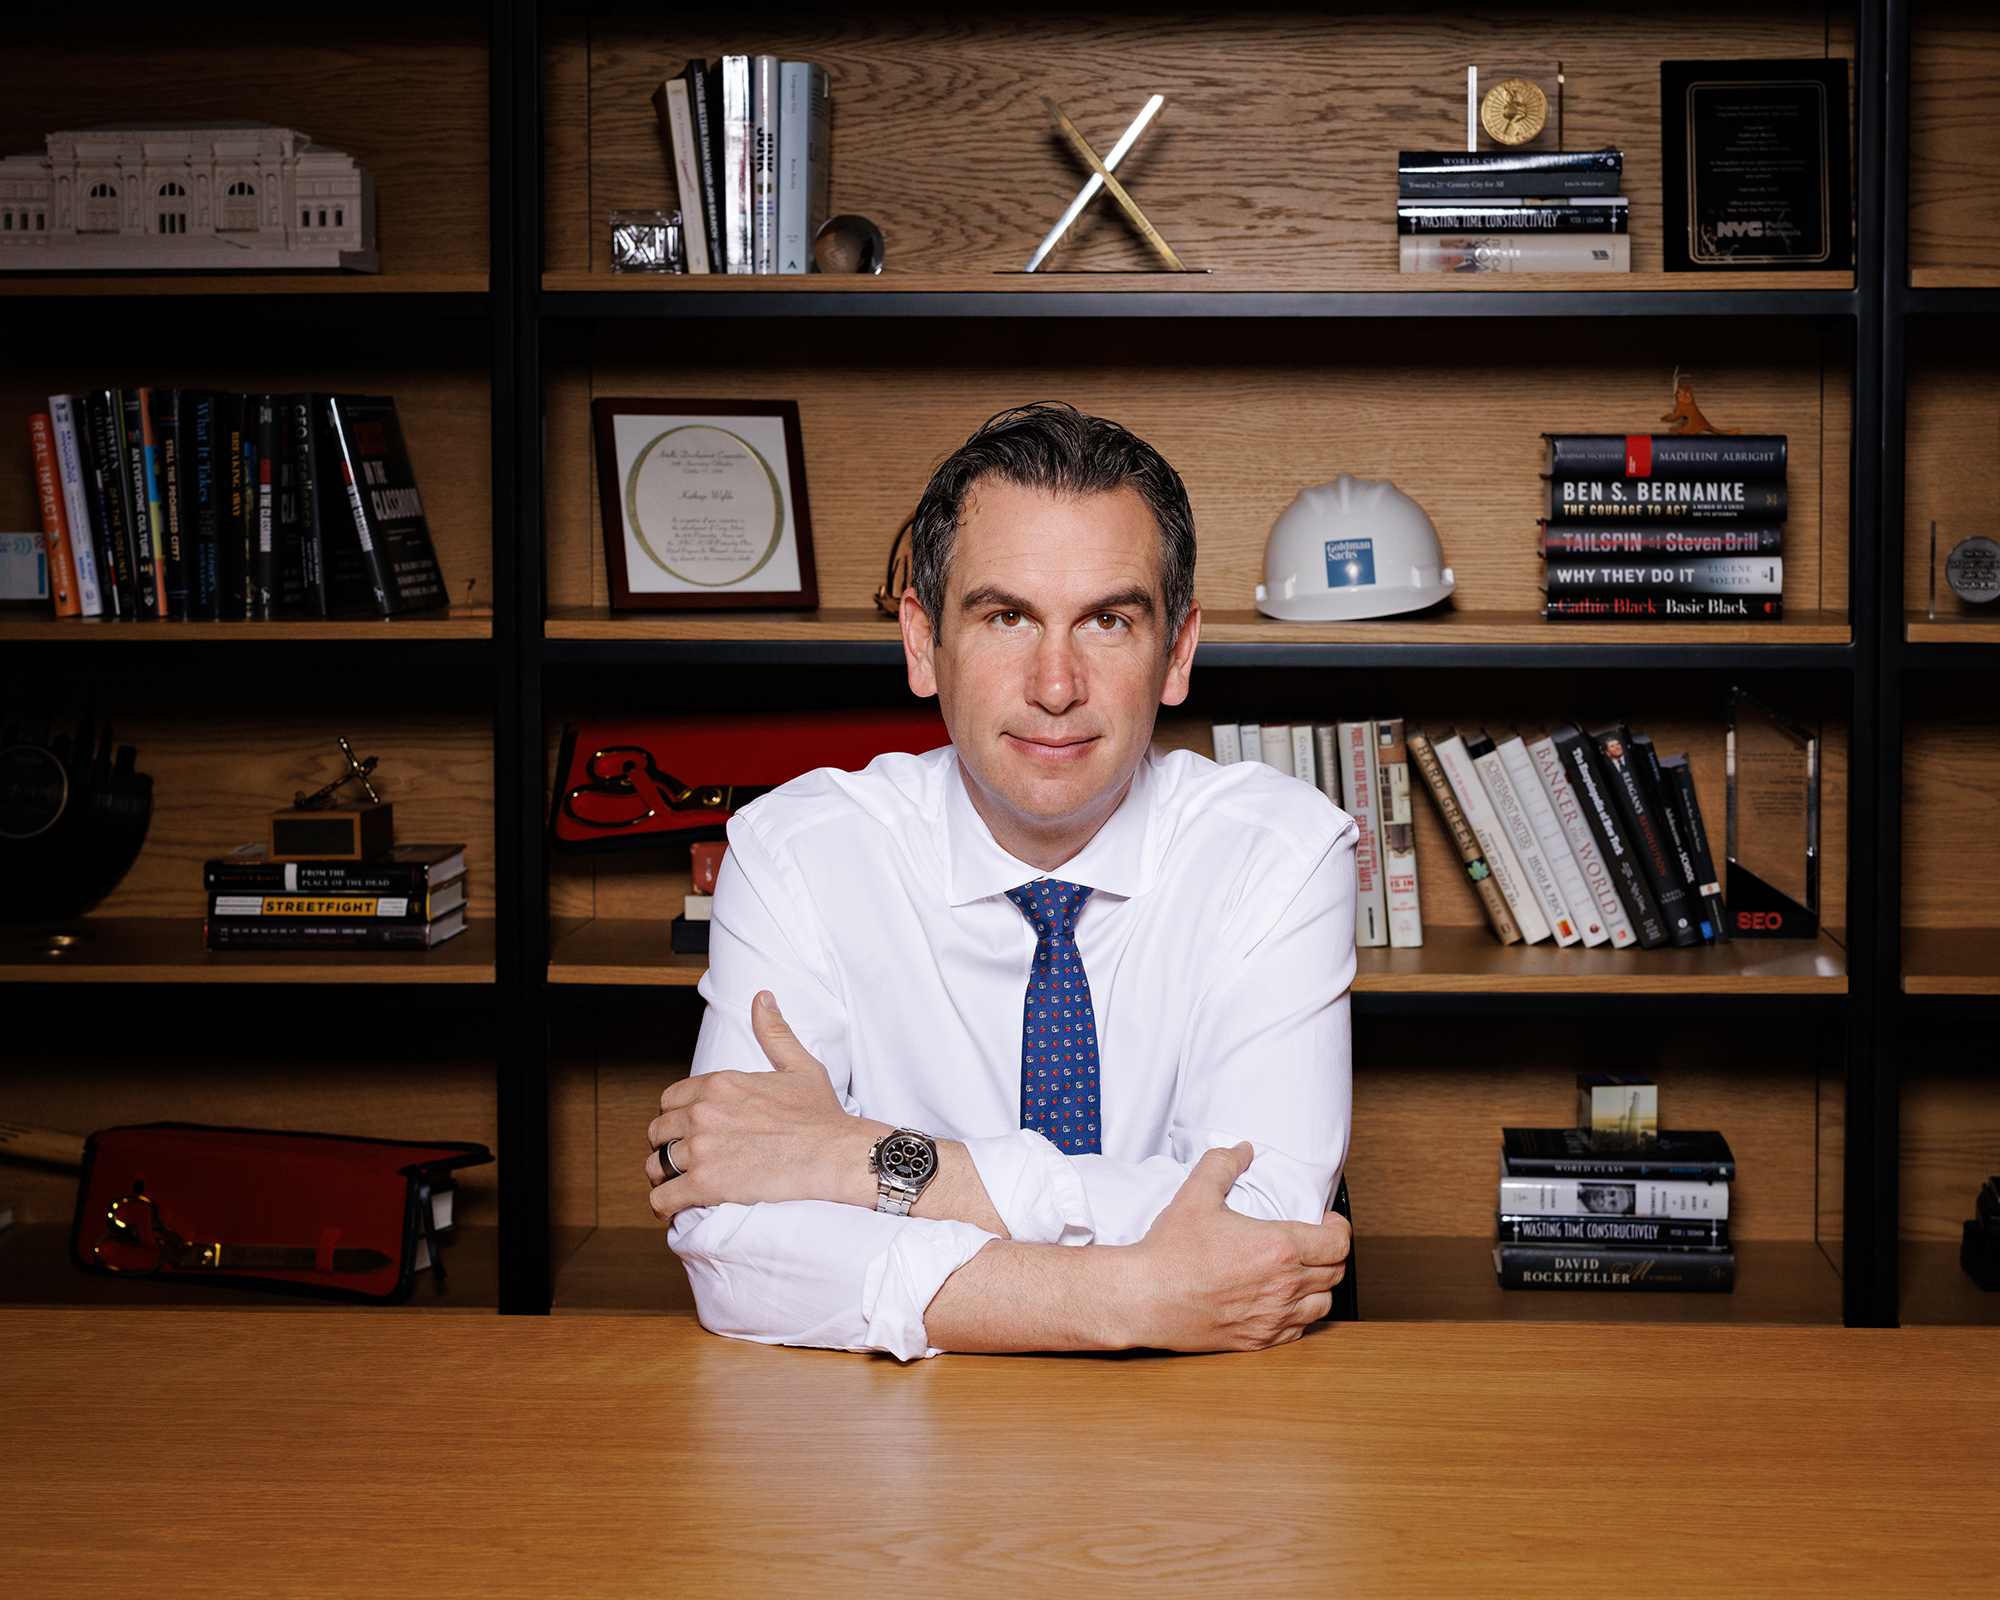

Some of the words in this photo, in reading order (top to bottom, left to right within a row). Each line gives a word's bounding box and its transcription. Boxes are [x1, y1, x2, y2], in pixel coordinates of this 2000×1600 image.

[698, 102, 708, 134] BETTER
[701, 136, 711, 159] THAN
[756, 127, 772, 173] JUNK
[703, 160, 713, 184] YOUR
[1442, 158, 1479, 166] WORLD
[707, 204, 718, 238] SEARCH
[1420, 215, 1459, 229] WASTING
[1463, 215, 1482, 229] TIME
[1484, 213, 1559, 229] CONSTRUCTIVELY
[1717, 221, 1762, 238] NYC
[195, 401, 210, 441] What
[293, 404, 308, 438] CEO
[30, 420, 49, 462] REAL
[164, 438, 175, 463] STILL
[130, 446, 140, 463] AN
[196, 446, 210, 458] It
[229, 431, 240, 487] BREAKING
[1659, 451, 1719, 461] MADELEINE
[1722, 452, 1776, 462] ALBRIGHT
[165, 465, 176, 482] THE
[197, 461, 211, 503] Takes
[37, 465, 58, 523] IMPACT
[132, 463, 145, 512] EVERYONE
[295, 443, 315, 528] Excellence
[1563, 481, 1603, 502] BEN
[1611, 481, 1628, 502] S.
[1637, 482, 1745, 502] BERNANKE
[108, 486, 119, 507] OFF
[231, 491, 241, 517] AWAY
[110, 508, 121, 528] THE
[166, 484, 179, 533] PROMISED
[1563, 504, 1585, 516] THE
[1589, 504, 1643, 516] COURAGE
[1647, 504, 1661, 516] TO
[1666, 504, 1688, 517] ACT
[136, 513, 149, 558] CULTURE
[1562, 532, 1643, 553] TAILSPIN
[1665, 532, 1721, 553] Steven
[1725, 532, 1759, 552] Brill
[113, 529, 128, 581] SIDELINES
[169, 534, 181, 561] CITY?
[1326, 540, 1371, 553] Goldman
[1327, 550, 1358, 562] Sachs
[1556, 568, 1597, 584] WHY
[1600, 568, 1646, 584] THEY
[1651, 568, 1674, 584] DO
[1679, 568, 1695, 584] IT
[1707, 564, 1753, 574] EUGENE
[1709, 576, 1752, 586] SOLTES
[1558, 597, 1610, 614] Cathie
[1614, 597, 1657, 614] Black
[1665, 598, 1705, 614] Basic
[1708, 598, 1749, 614] Black
[1349, 727, 1364, 749] POWER,
[1353, 750, 1365, 768] PASTA
[1570, 746, 1586, 764] The
[1354, 769, 1366, 782] AND
[1355, 783, 1368, 808] POLITICS
[1576, 761, 1605, 812] Encyclopedia
[1416, 743, 1447, 791] HARD
[1441, 795, 1475, 852] GREEN
[1484, 757, 1518, 815] ACHIEVEMENT
[1509, 812, 1534, 851] MATTERS
[1536, 748, 1579, 825] BANKER
[1577, 840, 1619, 918] WORLD
[1601, 818, 1616, 837] New
[1620, 770, 1644, 815] REAGAN'S
[1637, 813, 1668, 877] REVOLUTION
[1608, 835, 1625, 857] York
[301, 869, 327, 878] FROM
[329, 869, 346, 878] THE
[1357, 859, 1372, 892] D'AMATO
[1677, 851, 1696, 884] SCHOOL
[301, 879, 329, 888] PLACE
[330, 879, 344, 888] OF
[345, 879, 362, 888] THE
[364, 879, 391, 888] DEAD
[1528, 854, 1547, 883] HUGH
[1545, 890, 1564, 918] PRICE
[266, 901, 374, 913] STREETFIGHT
[1736, 911, 1783, 931] SEO
[1554, 1163, 1591, 1173] WORLD
[1594, 1164, 1624, 1174] CLASS
[1521, 1221, 1560, 1238] WASTING
[1564, 1222, 1584, 1239] TIME
[1587, 1223, 1659, 1240] CONSTRUCTIVELY
[1554, 1257, 1600, 1270] DAVID
[1523, 1270, 1631, 1285] ROCKEFELLER
